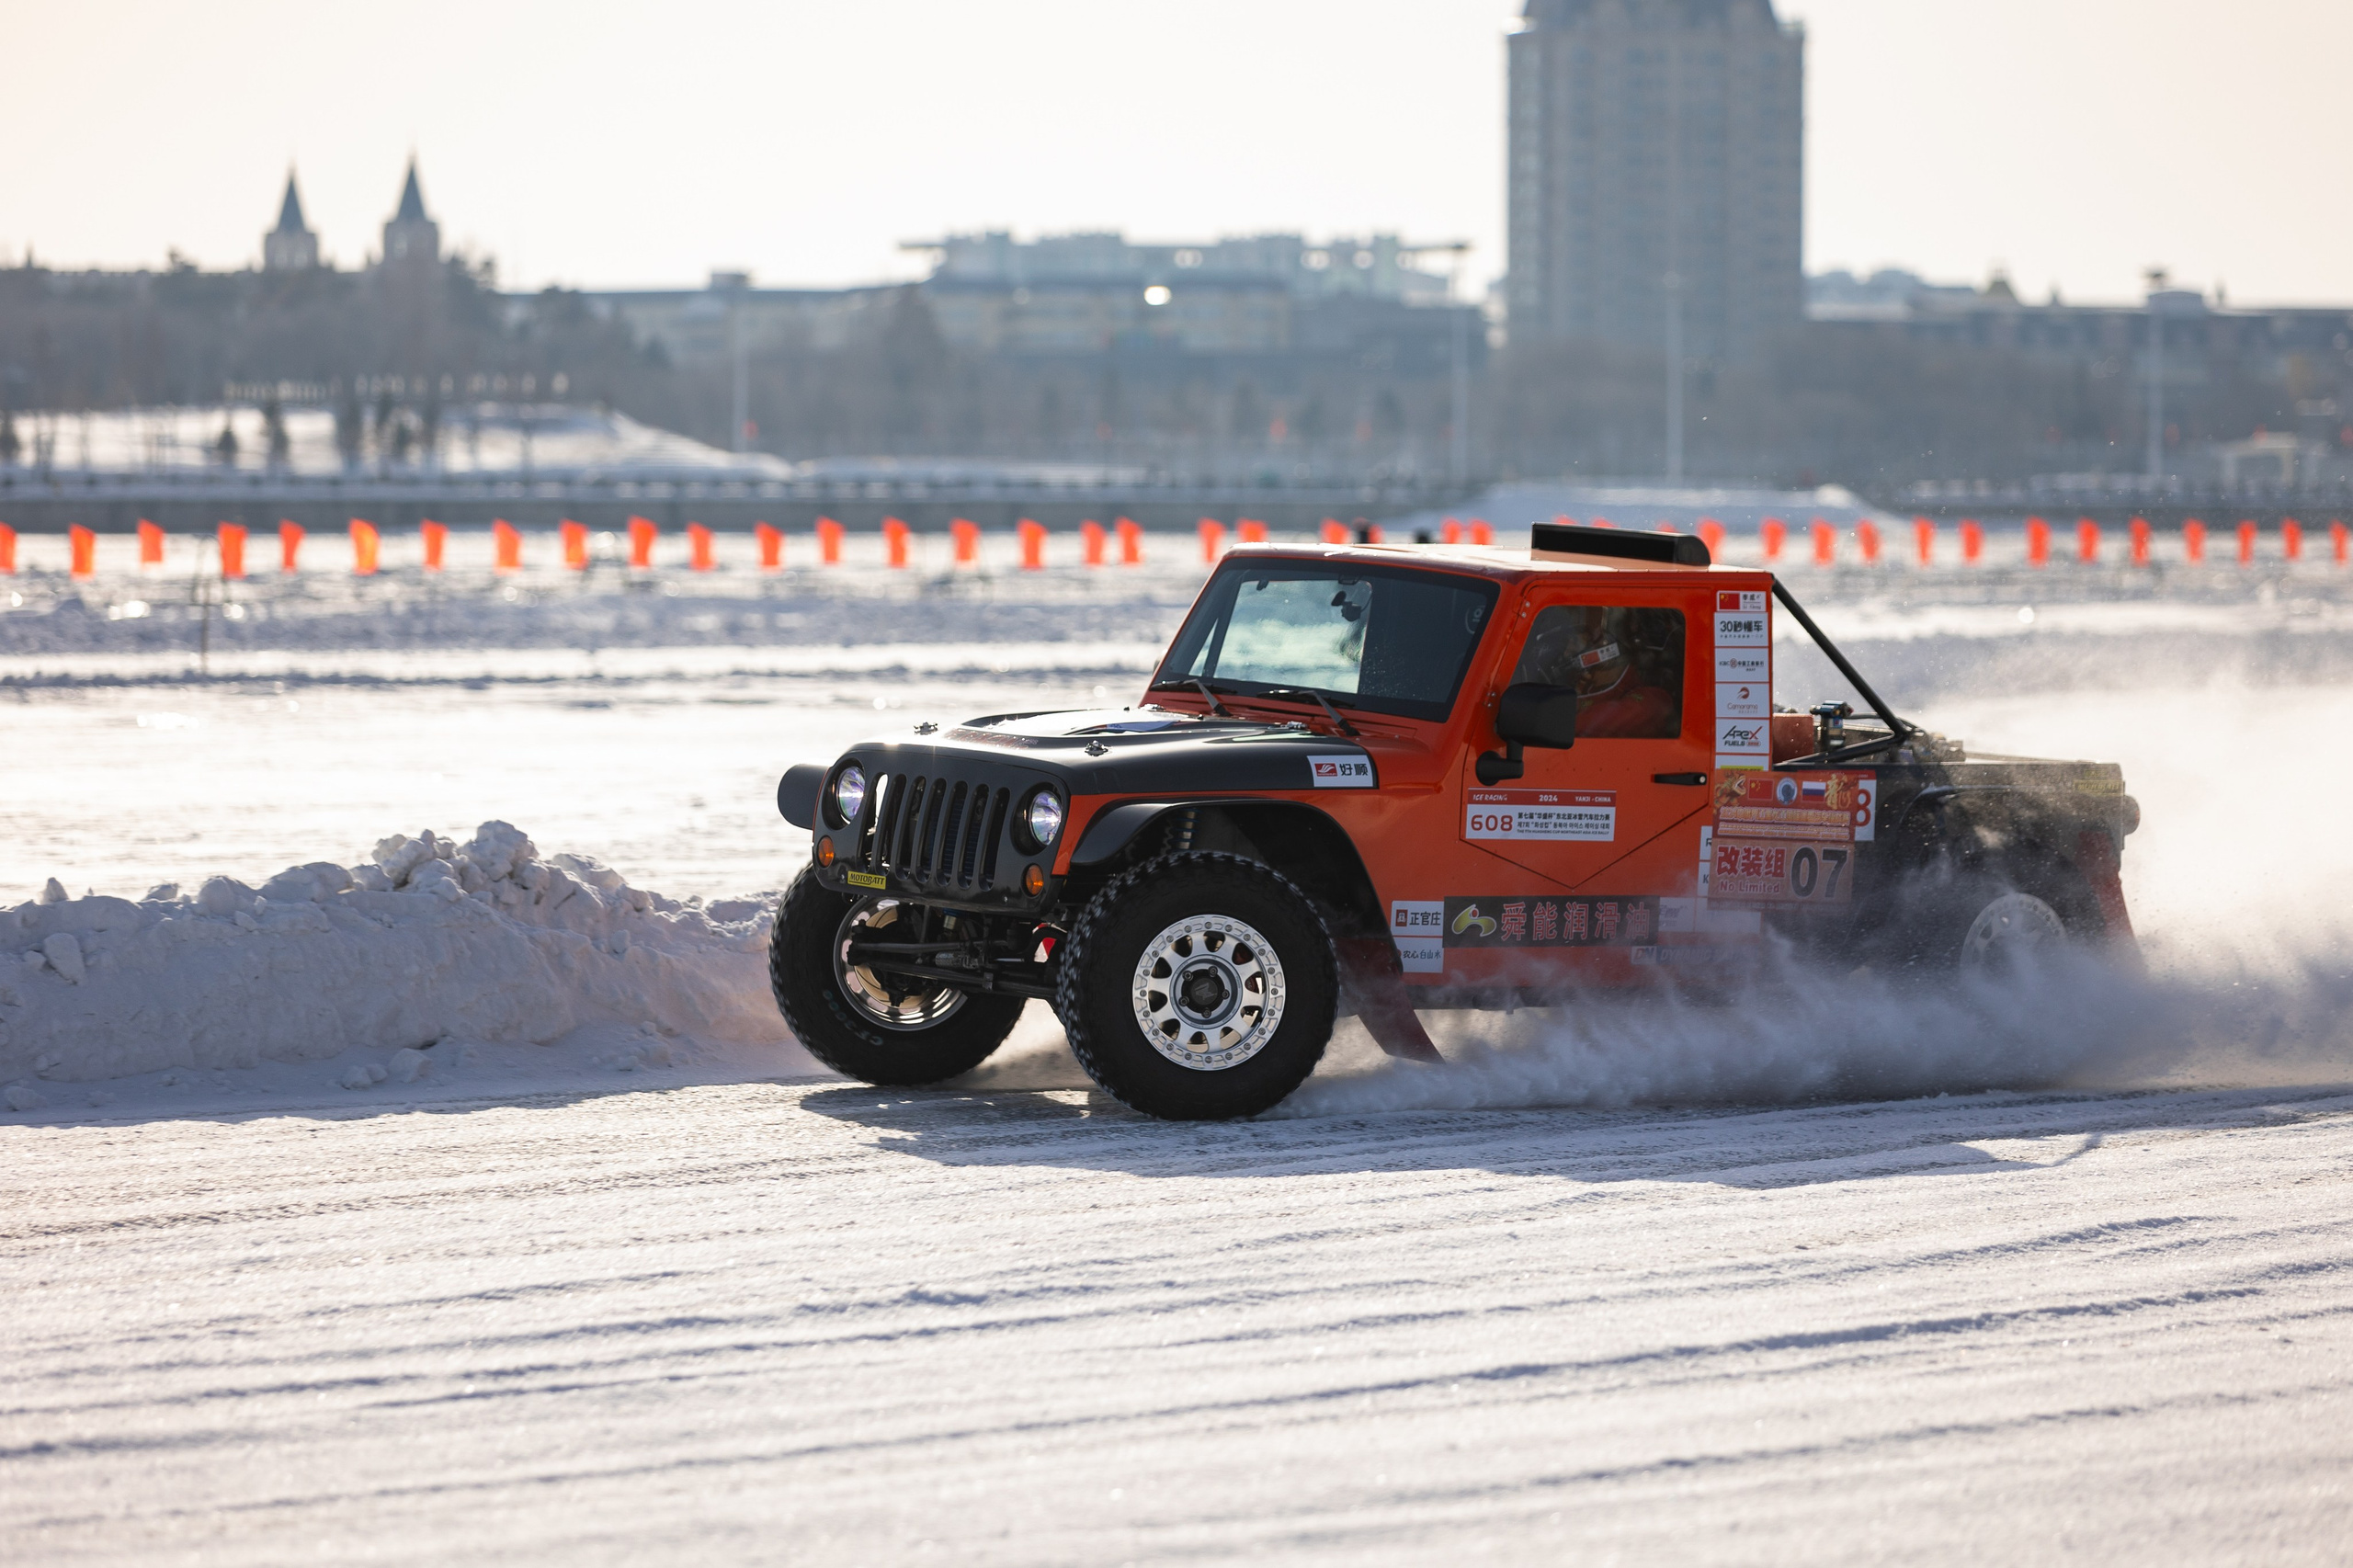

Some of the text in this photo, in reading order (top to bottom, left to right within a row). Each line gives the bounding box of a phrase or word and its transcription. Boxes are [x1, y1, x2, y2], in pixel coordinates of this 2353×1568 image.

[1720, 620, 1763, 632] 30秒懂车
[1339, 763, 1369, 777] 好顺
[1539, 794, 1558, 802] 2024
[1471, 814, 1513, 832] 608
[1717, 845, 1786, 878] 改装组
[850, 873, 885, 885] MOTOBATT
[1791, 846, 1849, 898] 07
[1720, 881, 1780, 893] No Limited
[1409, 911, 1441, 926] 正官庄
[1500, 901, 1651, 942] 舜能润滑油
